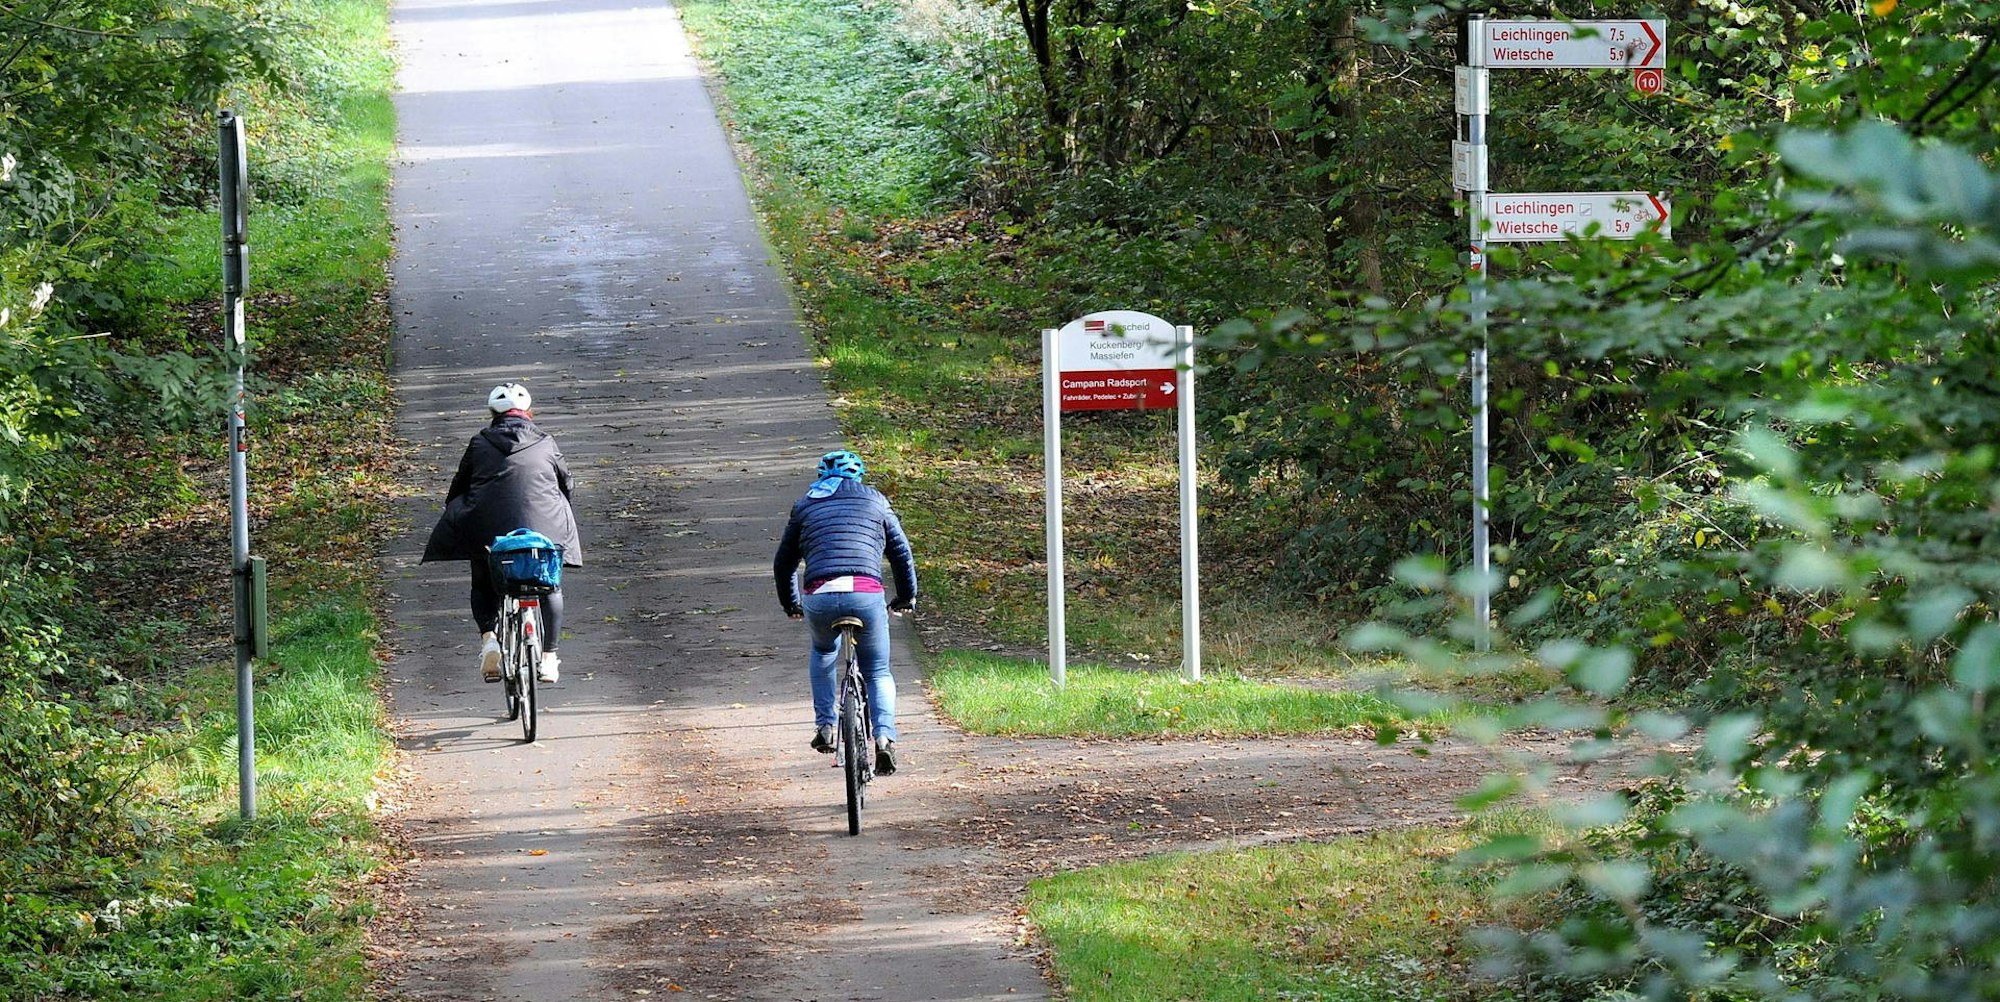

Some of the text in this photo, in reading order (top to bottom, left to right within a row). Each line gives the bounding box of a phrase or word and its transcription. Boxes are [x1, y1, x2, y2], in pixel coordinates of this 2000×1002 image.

[1492, 28, 1569, 43] Leichlingen
[1493, 48, 1554, 61] Wietsche
[1641, 78, 1656, 88] 10
[1495, 201, 1574, 217] Leichlingen
[1496, 221, 1559, 234] Wietsche
[1107, 323, 1150, 332] Bscheid
[1090, 352, 1135, 360] Massiefen
[1062, 378, 1147, 389] Campana Radsport
